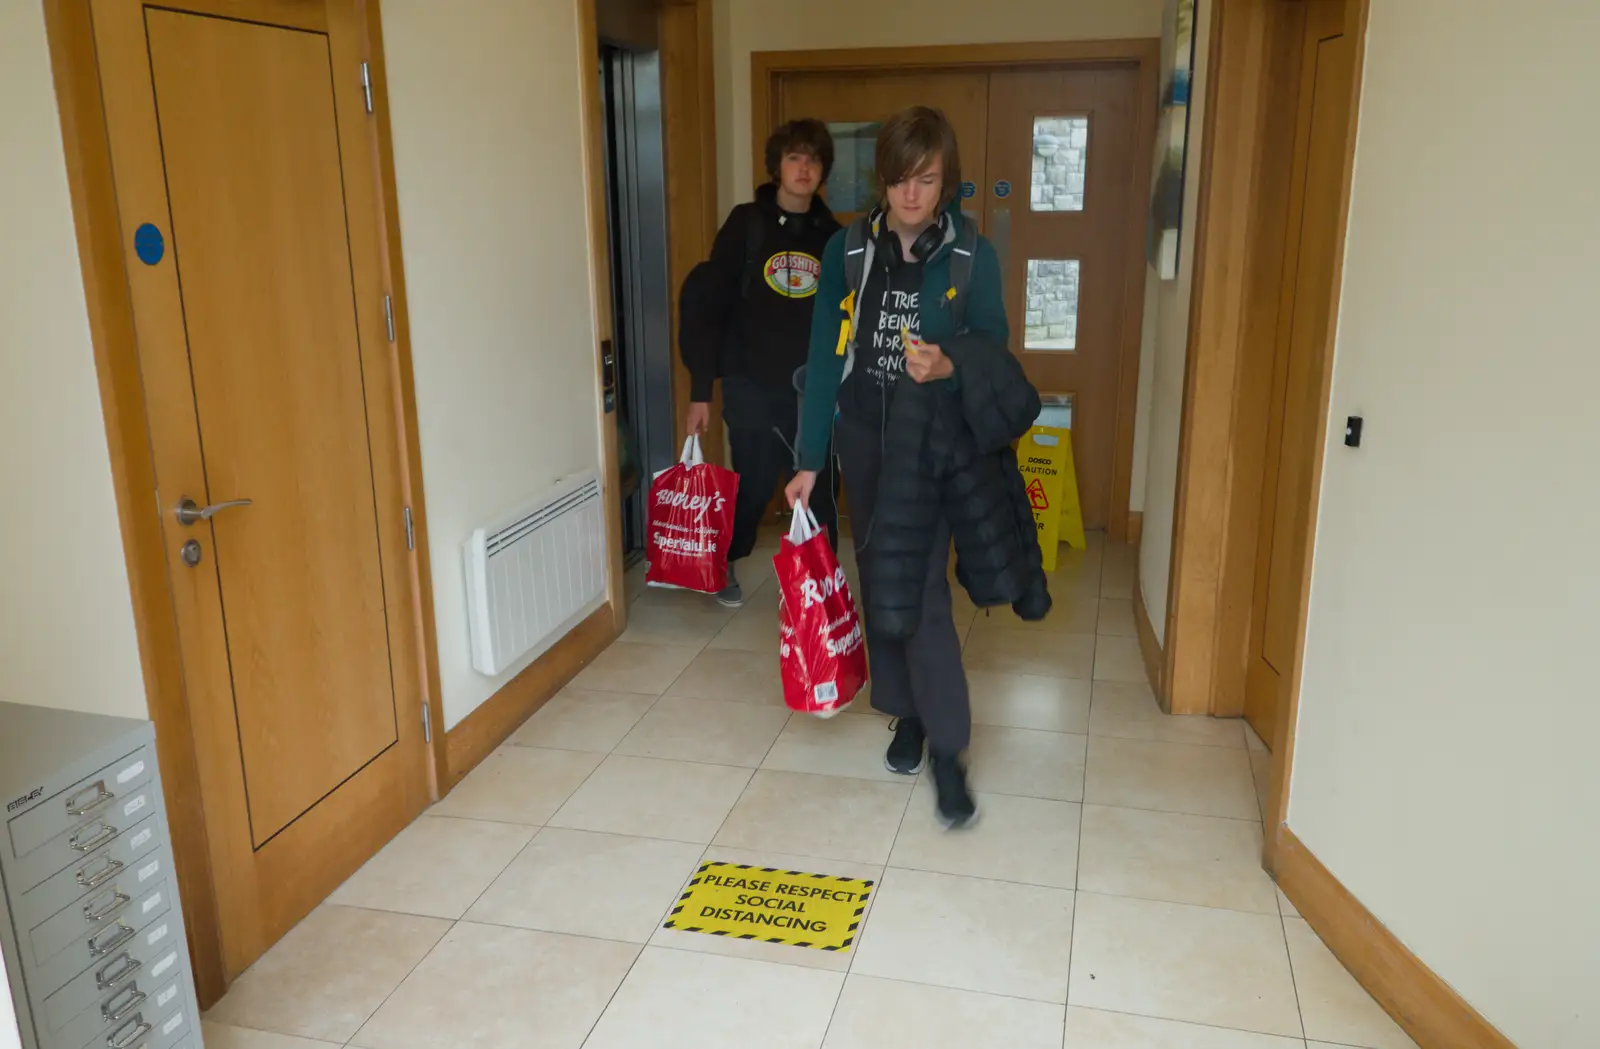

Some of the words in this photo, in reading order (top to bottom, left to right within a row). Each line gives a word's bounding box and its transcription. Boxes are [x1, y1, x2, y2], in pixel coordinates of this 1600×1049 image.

[892, 291, 919, 310] TRIE
[879, 310, 920, 332] BEING
[877, 355, 906, 373] ONC
[1028, 456, 1052, 465] DOSCO
[1019, 465, 1058, 476] CAUTION
[703, 874, 771, 892] PLEASE
[775, 883, 857, 903] RESPECT
[735, 894, 806, 913] SOCIAL
[699, 906, 828, 933] DISTANCING
